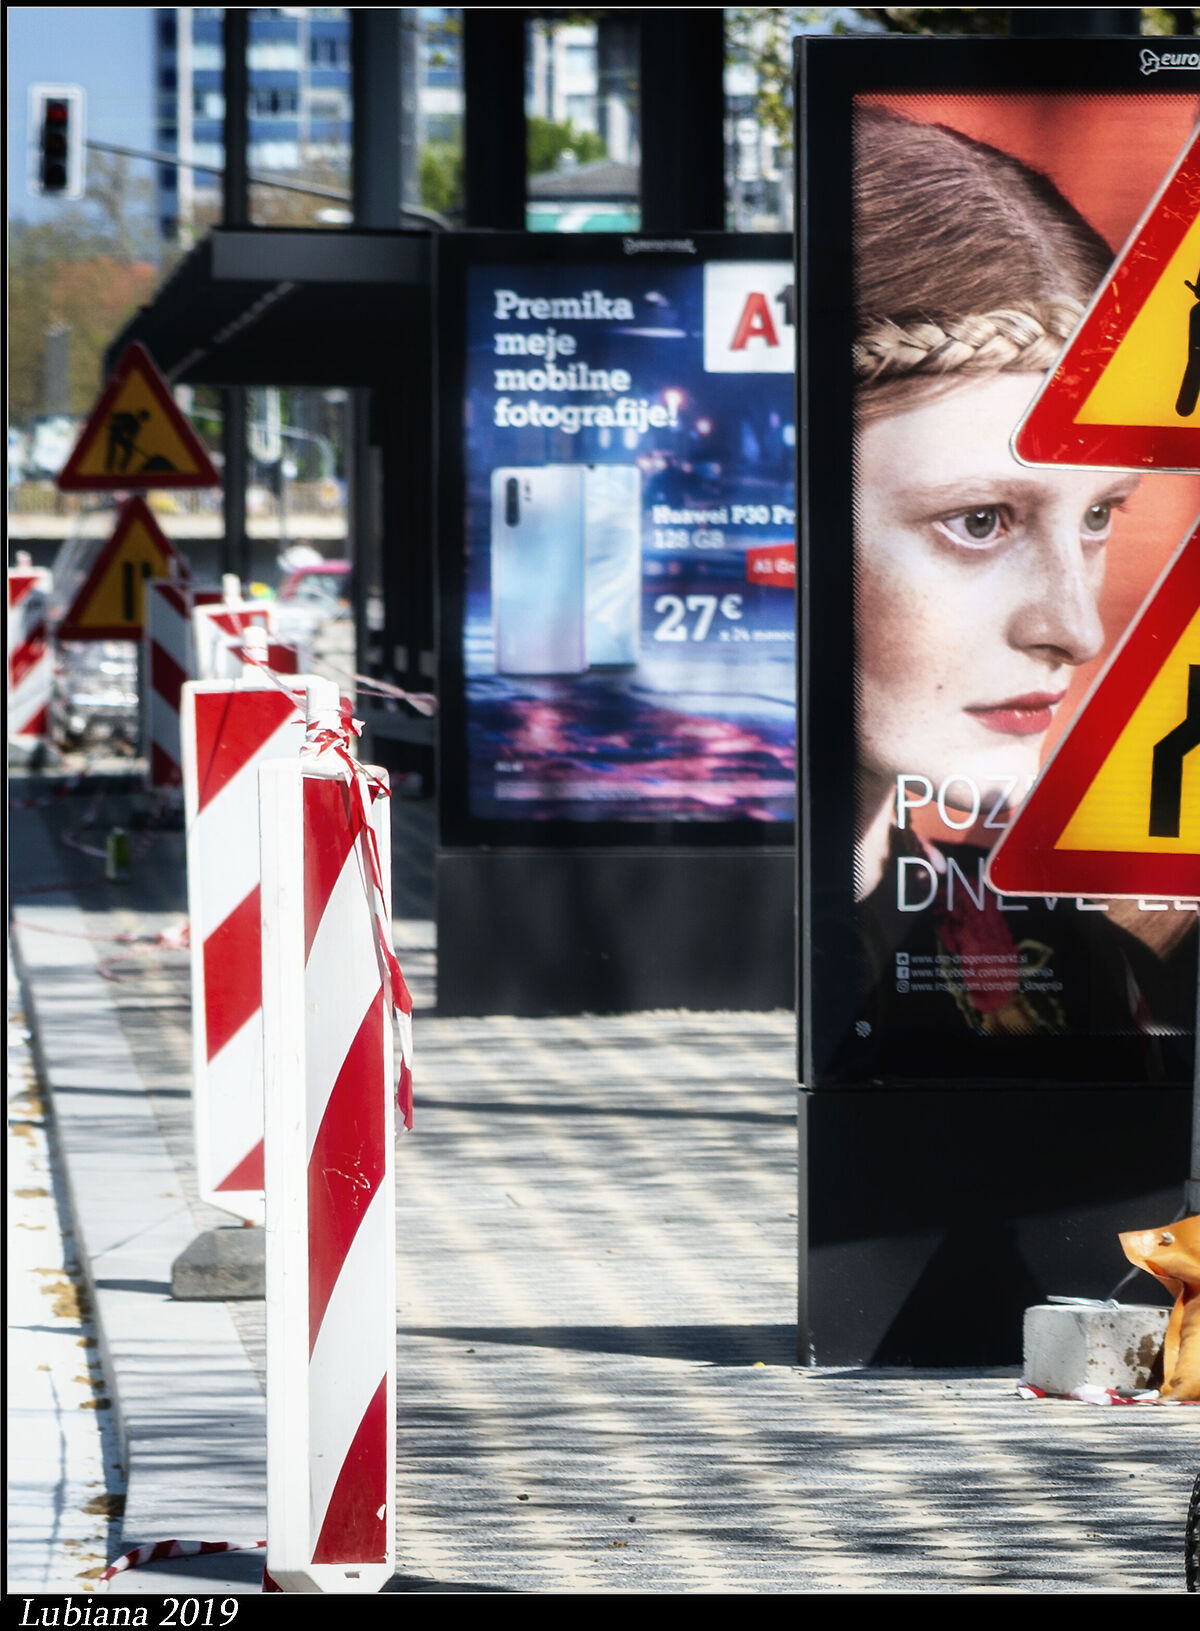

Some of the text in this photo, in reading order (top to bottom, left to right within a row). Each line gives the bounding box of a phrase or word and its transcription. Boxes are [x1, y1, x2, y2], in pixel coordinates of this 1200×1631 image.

[494, 289, 635, 320] Premika
[494, 326, 577, 361] meje
[494, 363, 632, 392] mobilne
[494, 395, 680, 434] fotografije!
[652, 505, 729, 524] Huawei
[731, 505, 770, 524] P30
[653, 529, 725, 549] 128 GB
